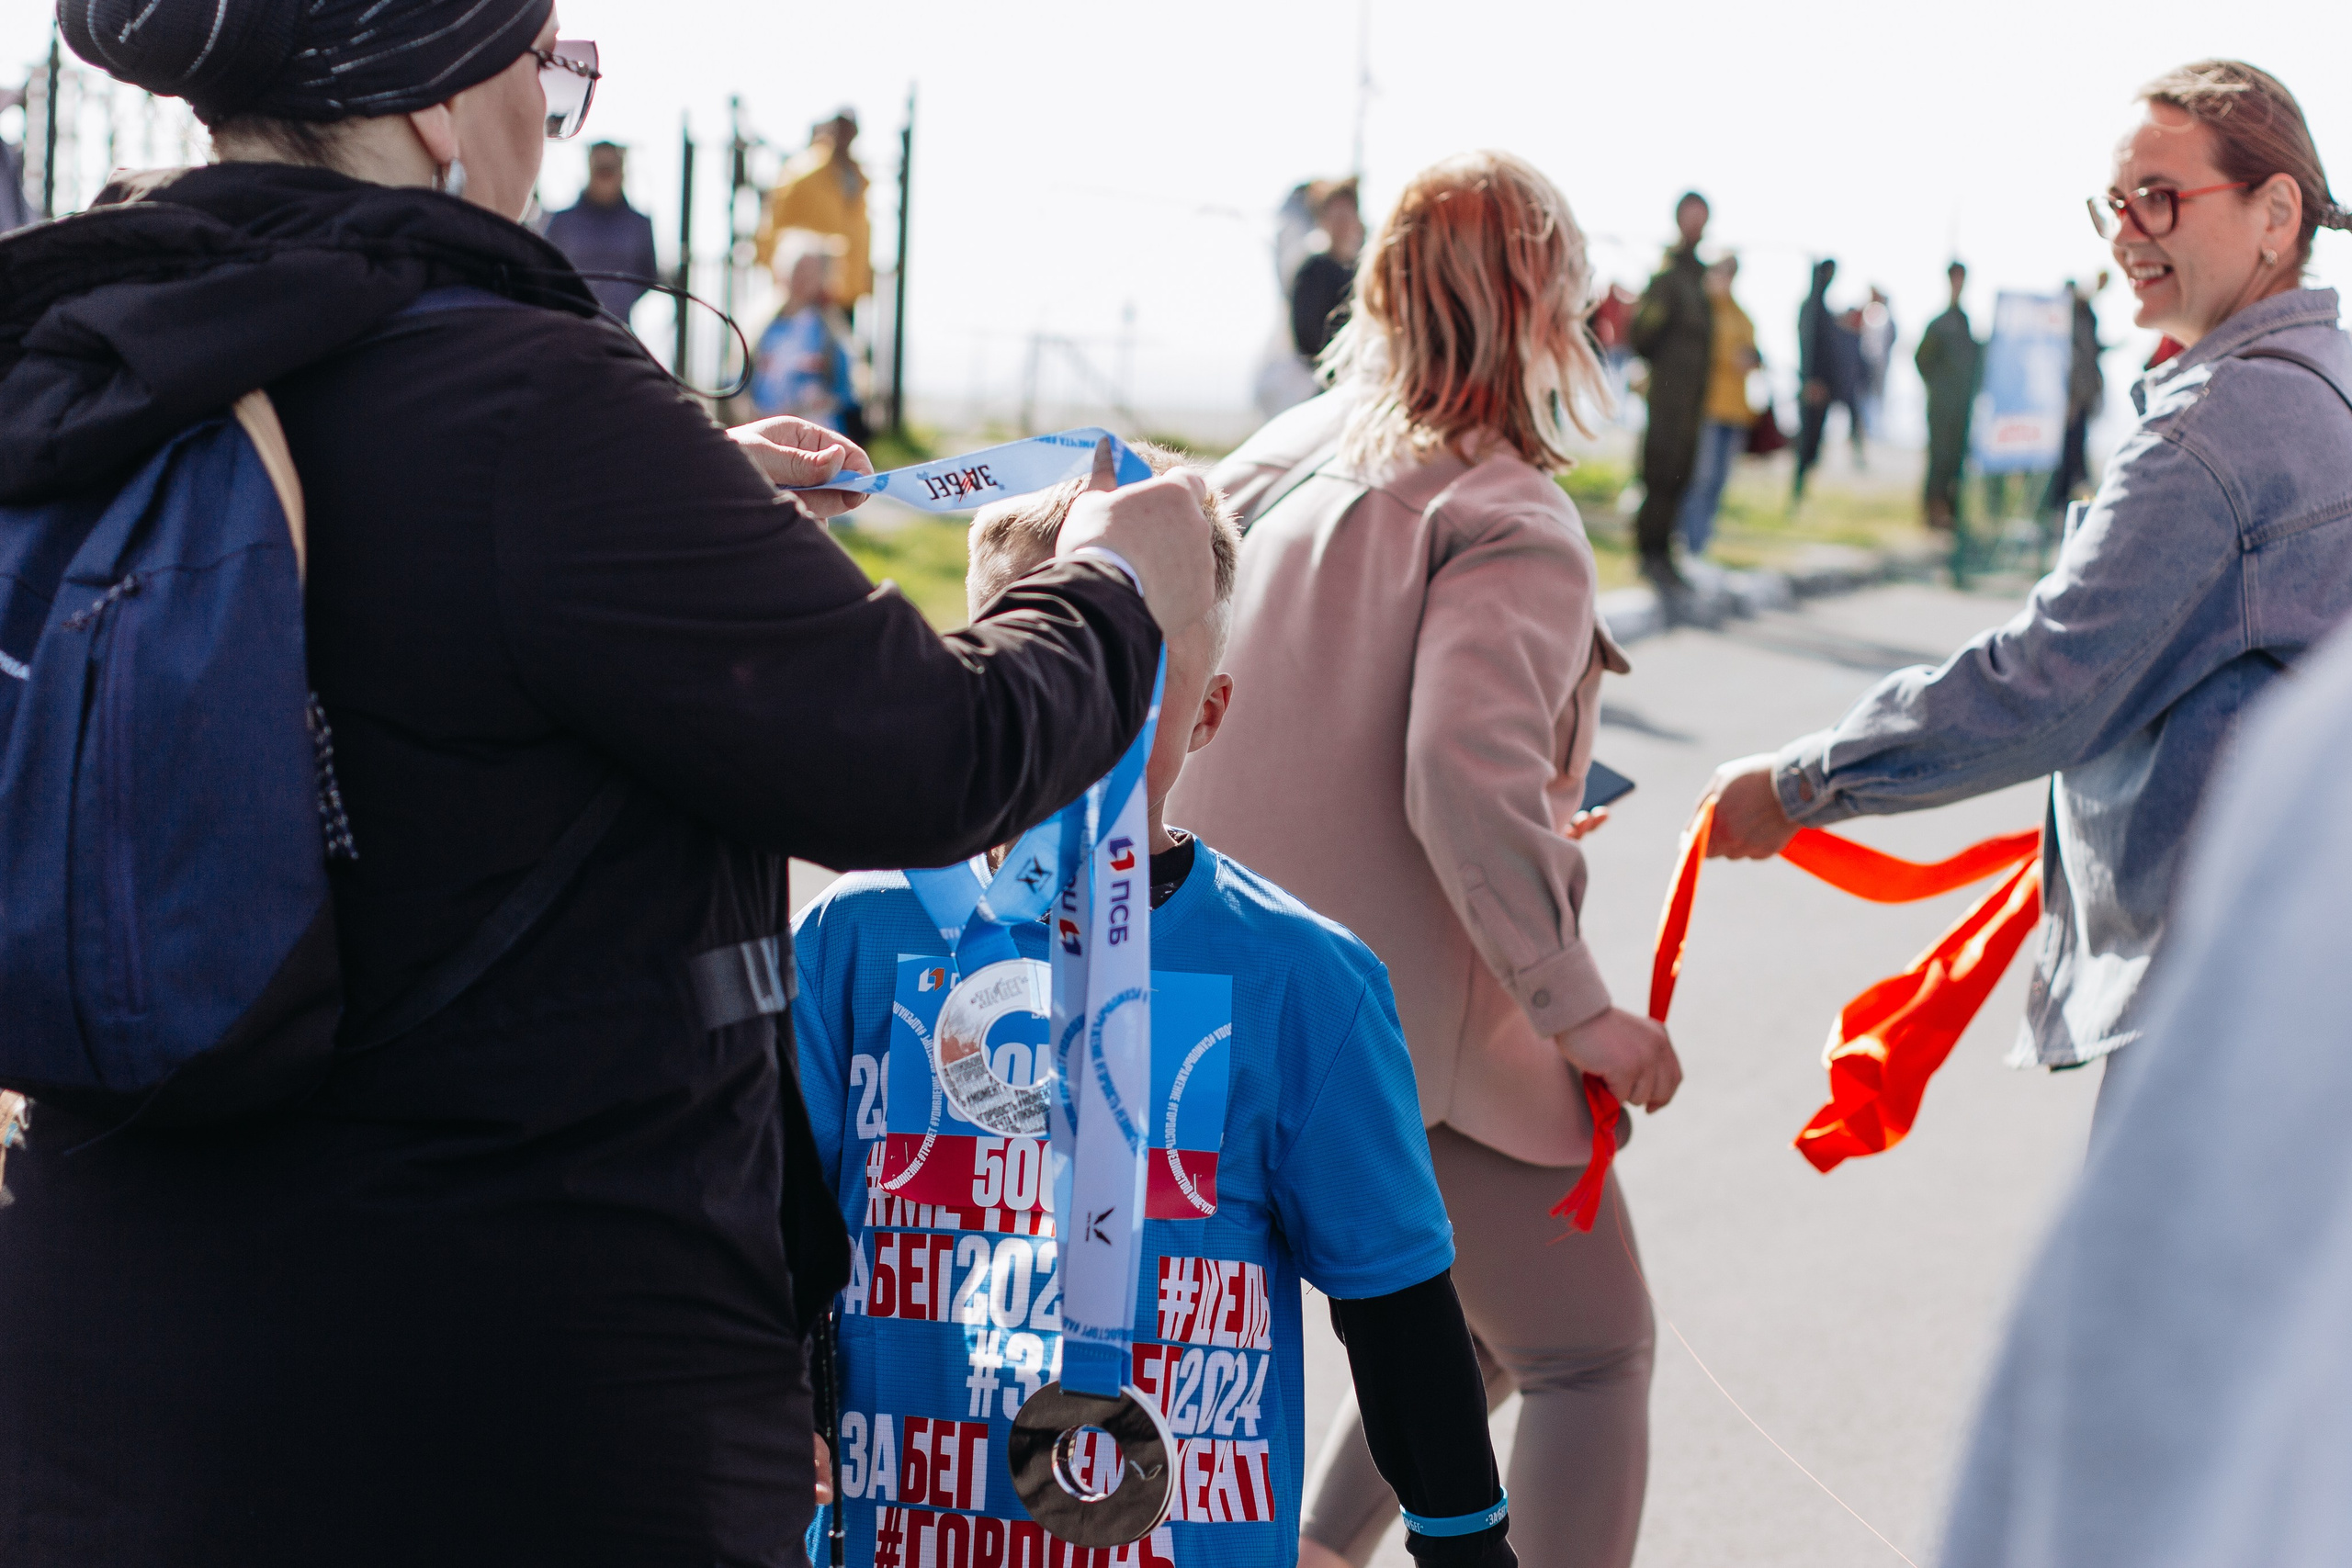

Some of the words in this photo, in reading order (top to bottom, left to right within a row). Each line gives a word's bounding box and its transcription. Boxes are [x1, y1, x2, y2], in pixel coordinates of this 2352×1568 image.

[1109, 879, 1130, 946] ПСБ
[1169, 1032, 1217, 1102] #САМОВЫРАЖЕНИЕ
[917, 1126, 938, 1162] #ТРЕПЕТ
[1164, 1101, 1179, 1149] #ГОРДОСТЬ
[1166, 1149, 1194, 1195] #ЕДИНСТВО
[841, 1410, 989, 1512] ЗАБЕГ
